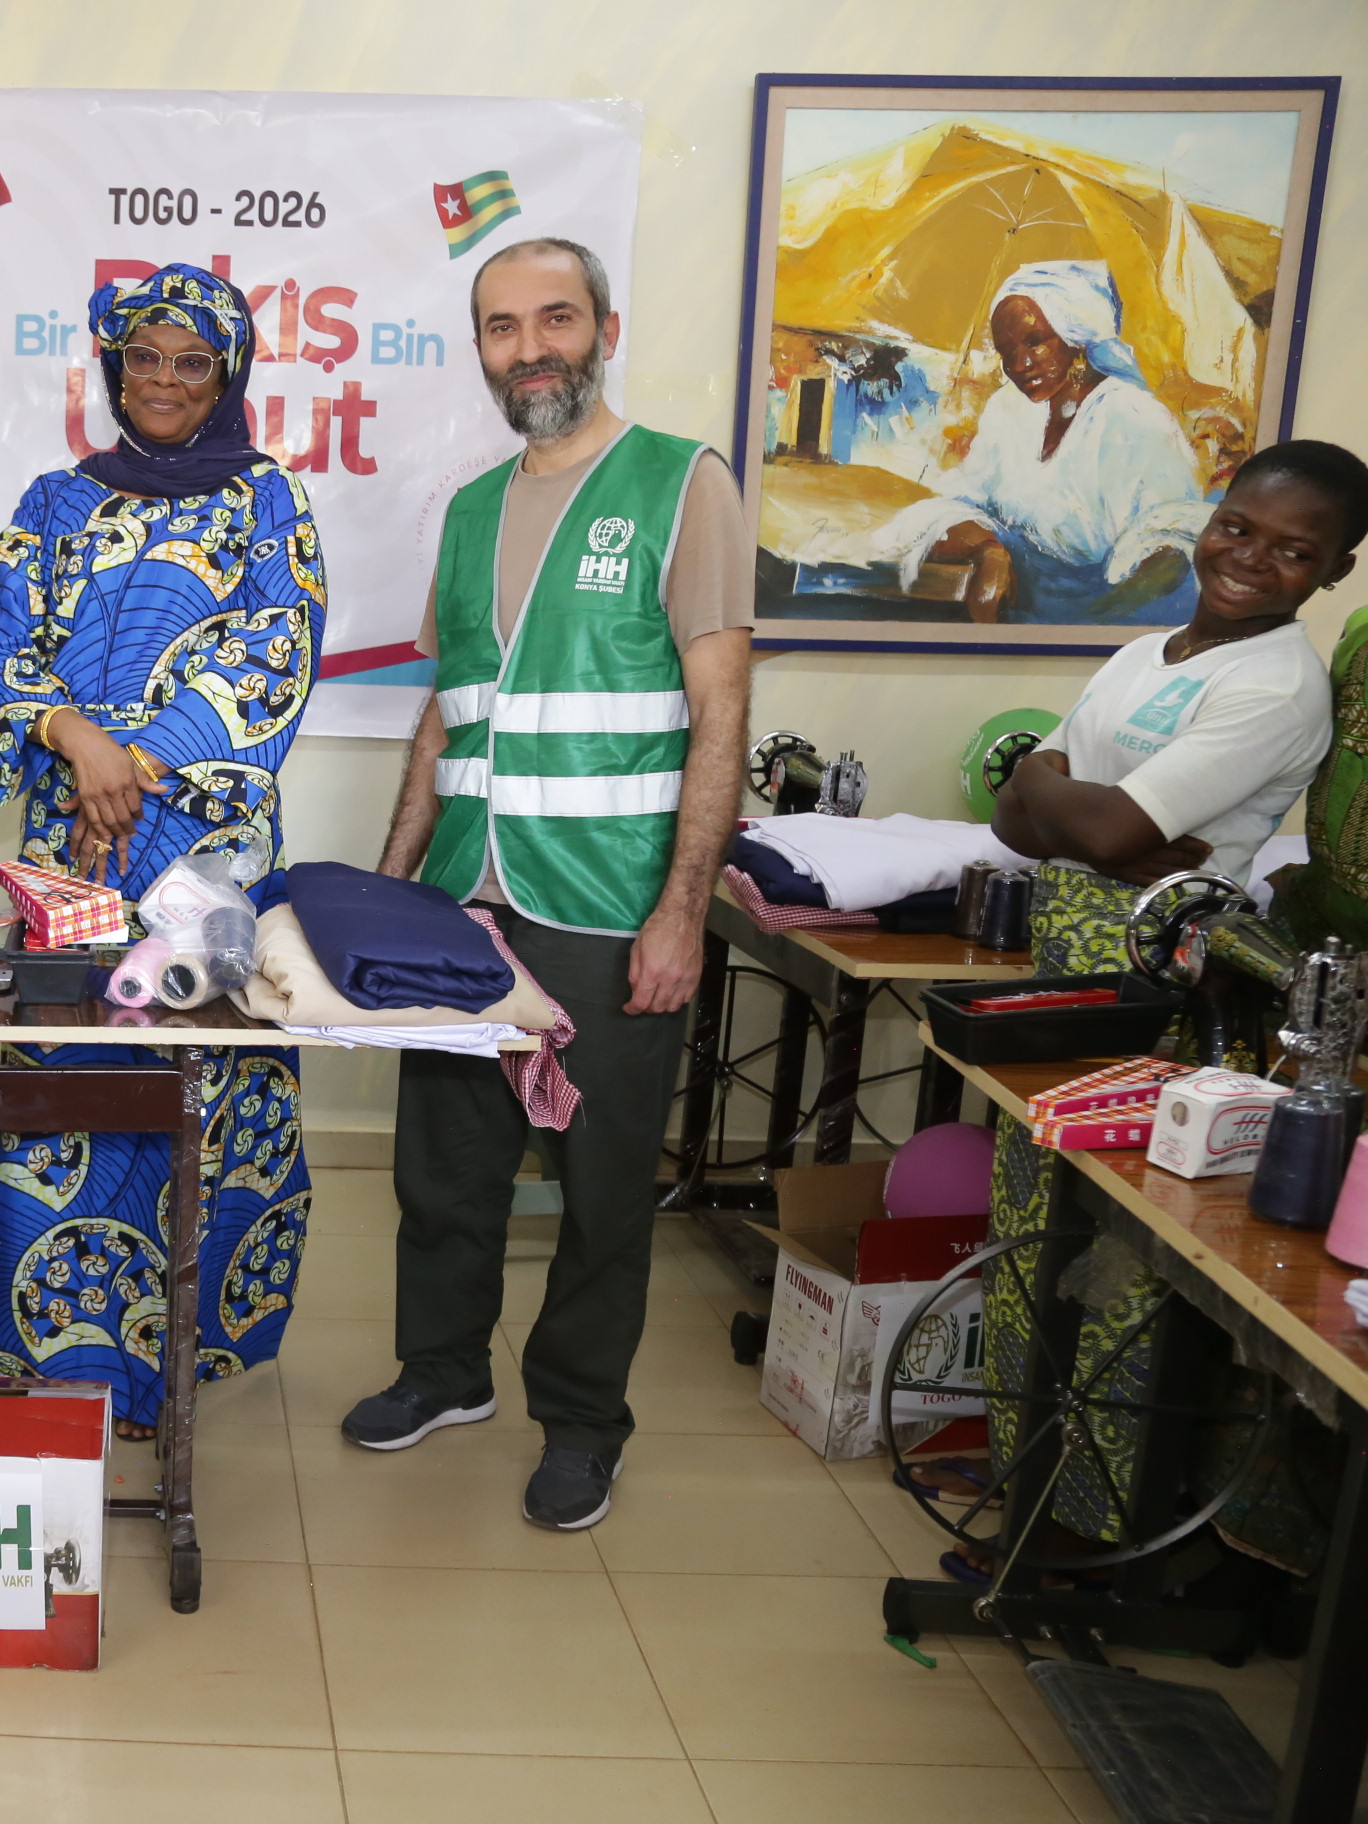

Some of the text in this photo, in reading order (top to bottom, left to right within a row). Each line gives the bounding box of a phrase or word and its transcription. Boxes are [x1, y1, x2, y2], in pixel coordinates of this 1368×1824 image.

[108, 187, 198, 225] TOGO
[233, 190, 327, 228] 2026
[14, 309, 78, 357] Bir
[371, 318, 445, 367] Bin
[575, 583, 597, 591] KONYA
[785, 1264, 835, 1315] FLYINGMAN
[2, 1575, 33, 1587] VAKFI
